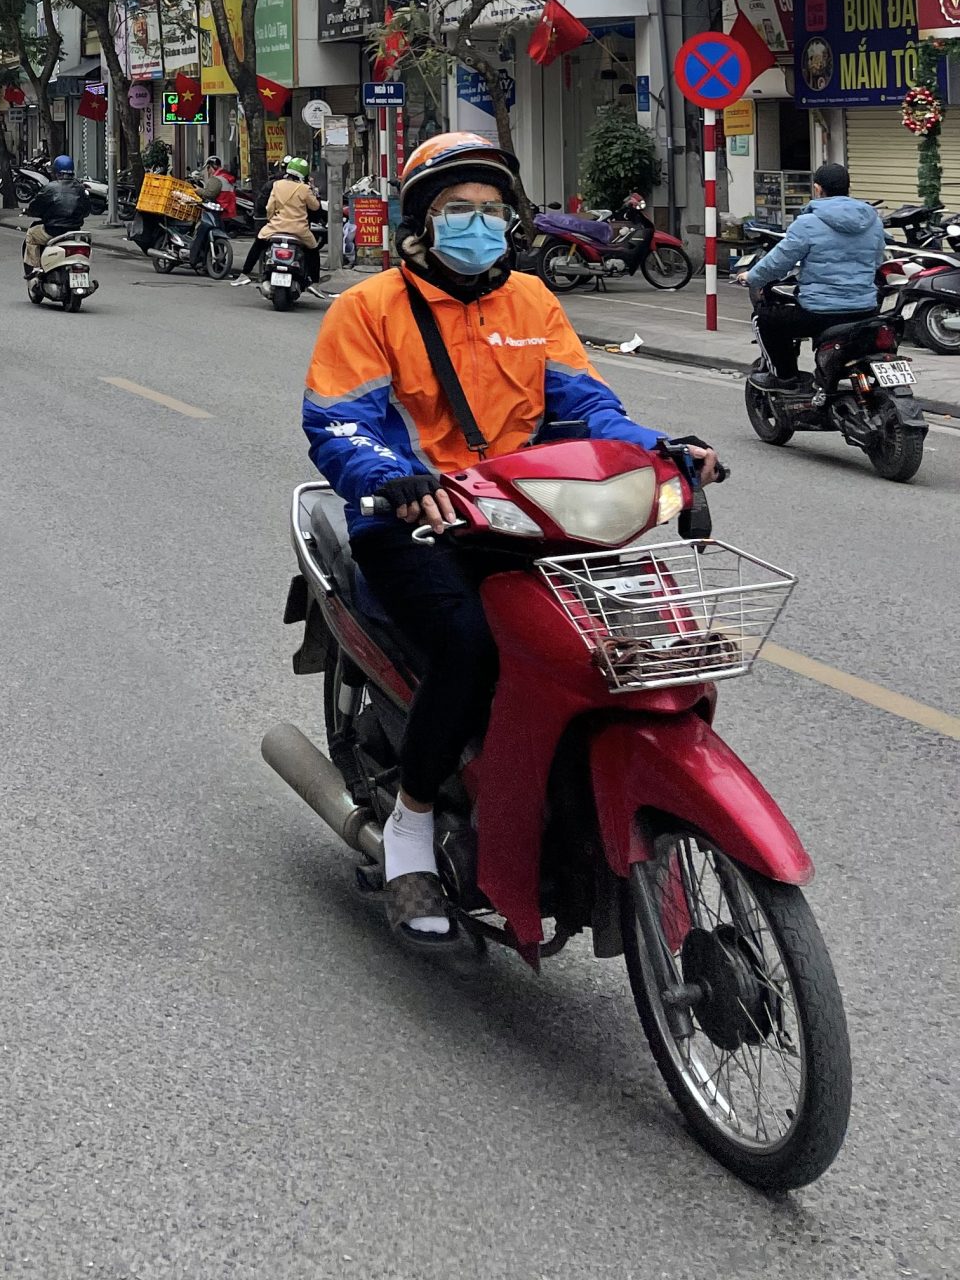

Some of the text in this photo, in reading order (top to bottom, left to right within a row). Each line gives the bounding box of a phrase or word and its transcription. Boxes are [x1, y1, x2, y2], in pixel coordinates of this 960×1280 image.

[840, 36, 919, 90] MẮM TÔ
[358, 216, 383, 225] CHỤP
